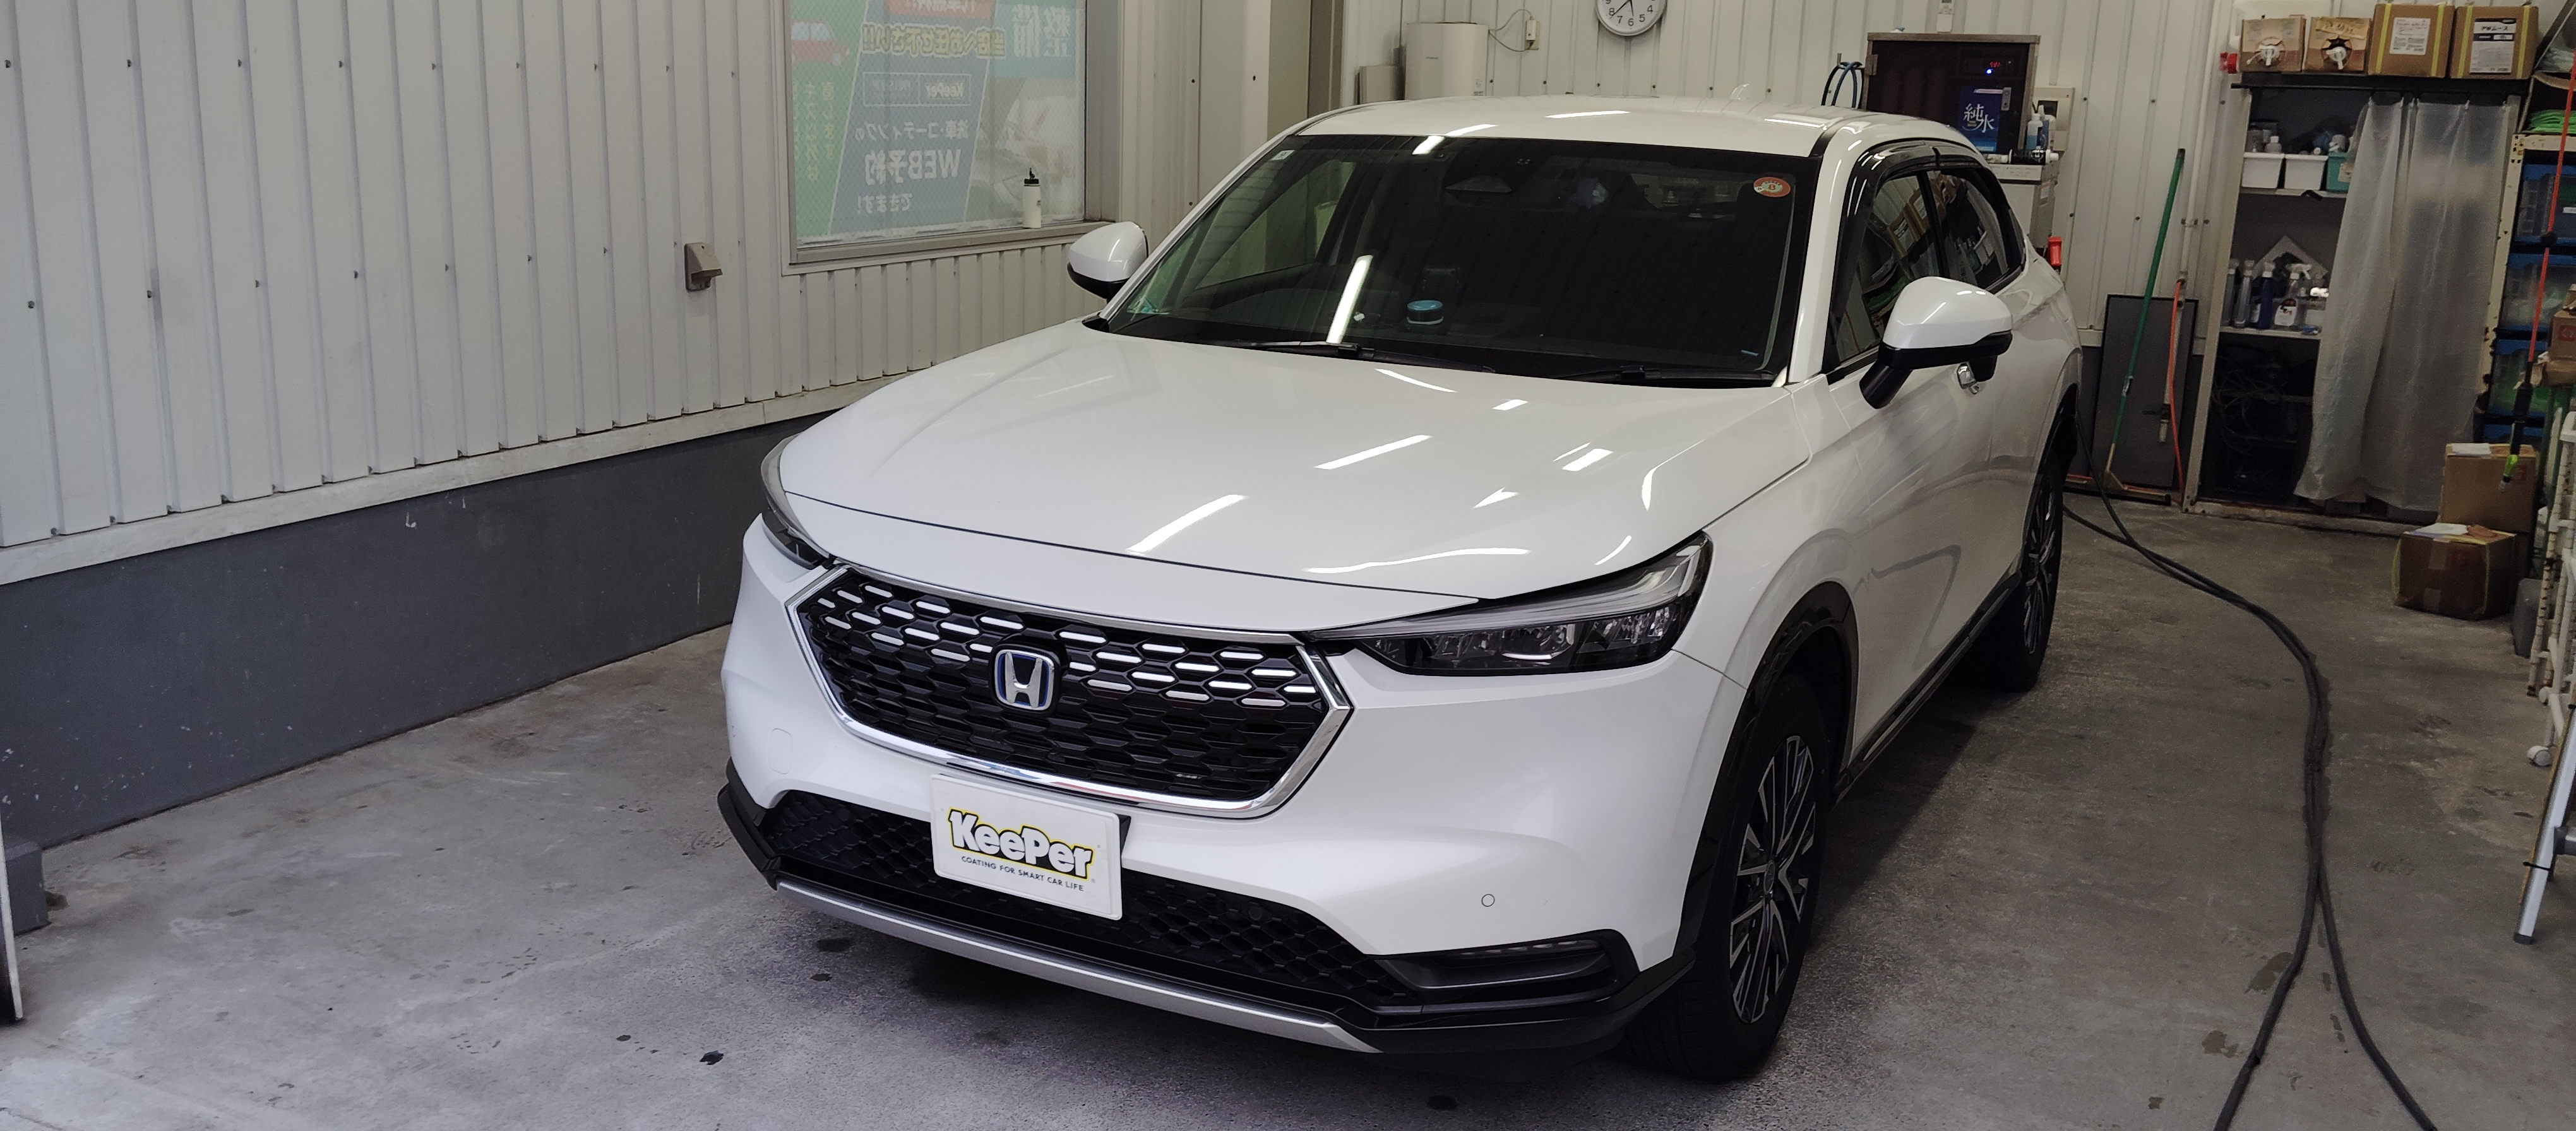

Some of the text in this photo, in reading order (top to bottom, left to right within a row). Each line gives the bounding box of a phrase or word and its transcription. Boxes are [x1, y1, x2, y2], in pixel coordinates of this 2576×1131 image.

[1608, 8, 1615, 16] 8
[1647, 4, 1653, 13] 4
[1617, 15, 1623, 24] 7
[1628, 18, 1634, 27] 6
[1638, 14, 1645, 22] 5
[1963, 103, 1995, 133] 純水
[948, 808, 1094, 880] KeePer
[961, 856, 1084, 891] COATING FOR SMART CAR LIFE
